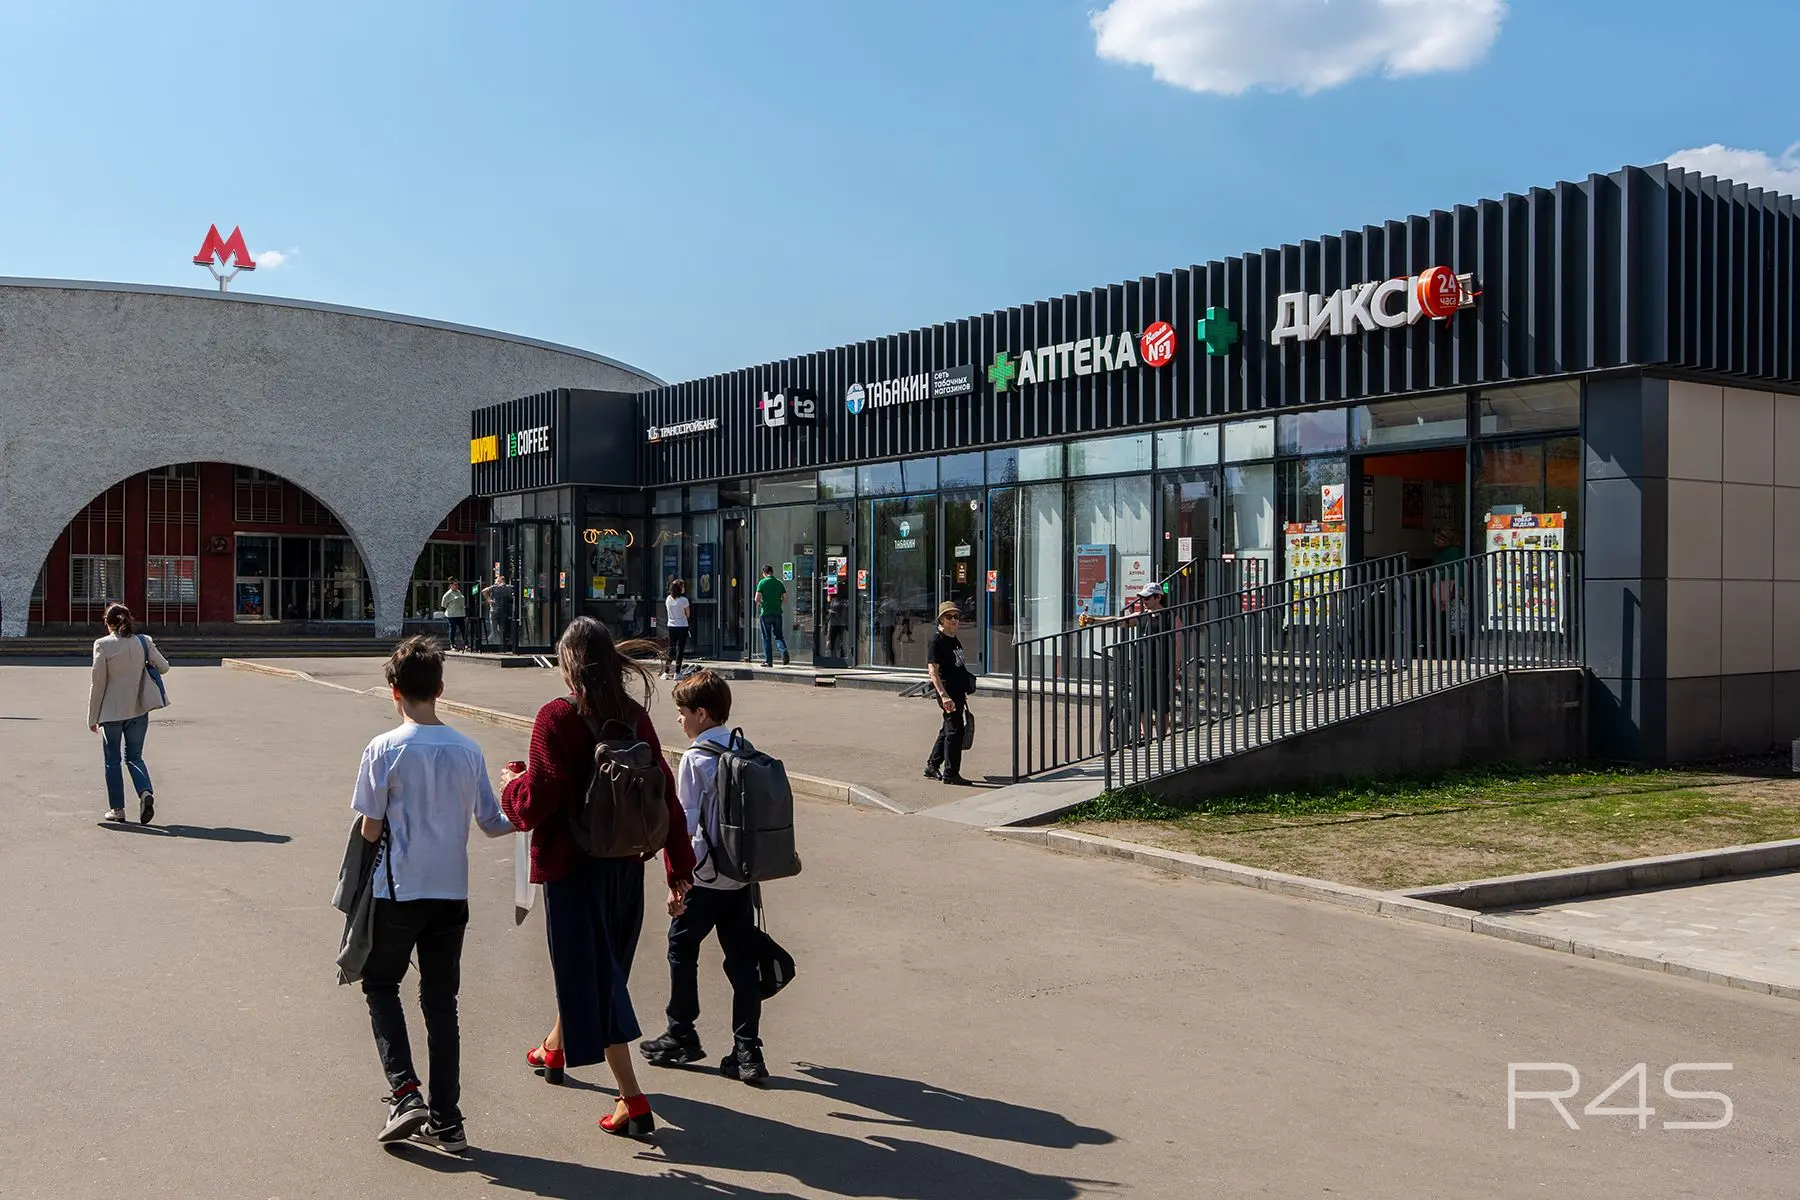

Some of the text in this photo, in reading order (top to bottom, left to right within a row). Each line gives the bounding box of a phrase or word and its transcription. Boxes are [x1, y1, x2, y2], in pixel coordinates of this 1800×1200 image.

[1437, 274, 1456, 293] 24
[1017, 331, 1138, 387] АПТЕКА
[934, 371, 950, 380] сеть
[934, 376, 968, 389] табачных
[866, 372, 930, 409] ТАБАКИН
[934, 383, 971, 395] магазинов
[517, 425, 549, 456] COFFEE
